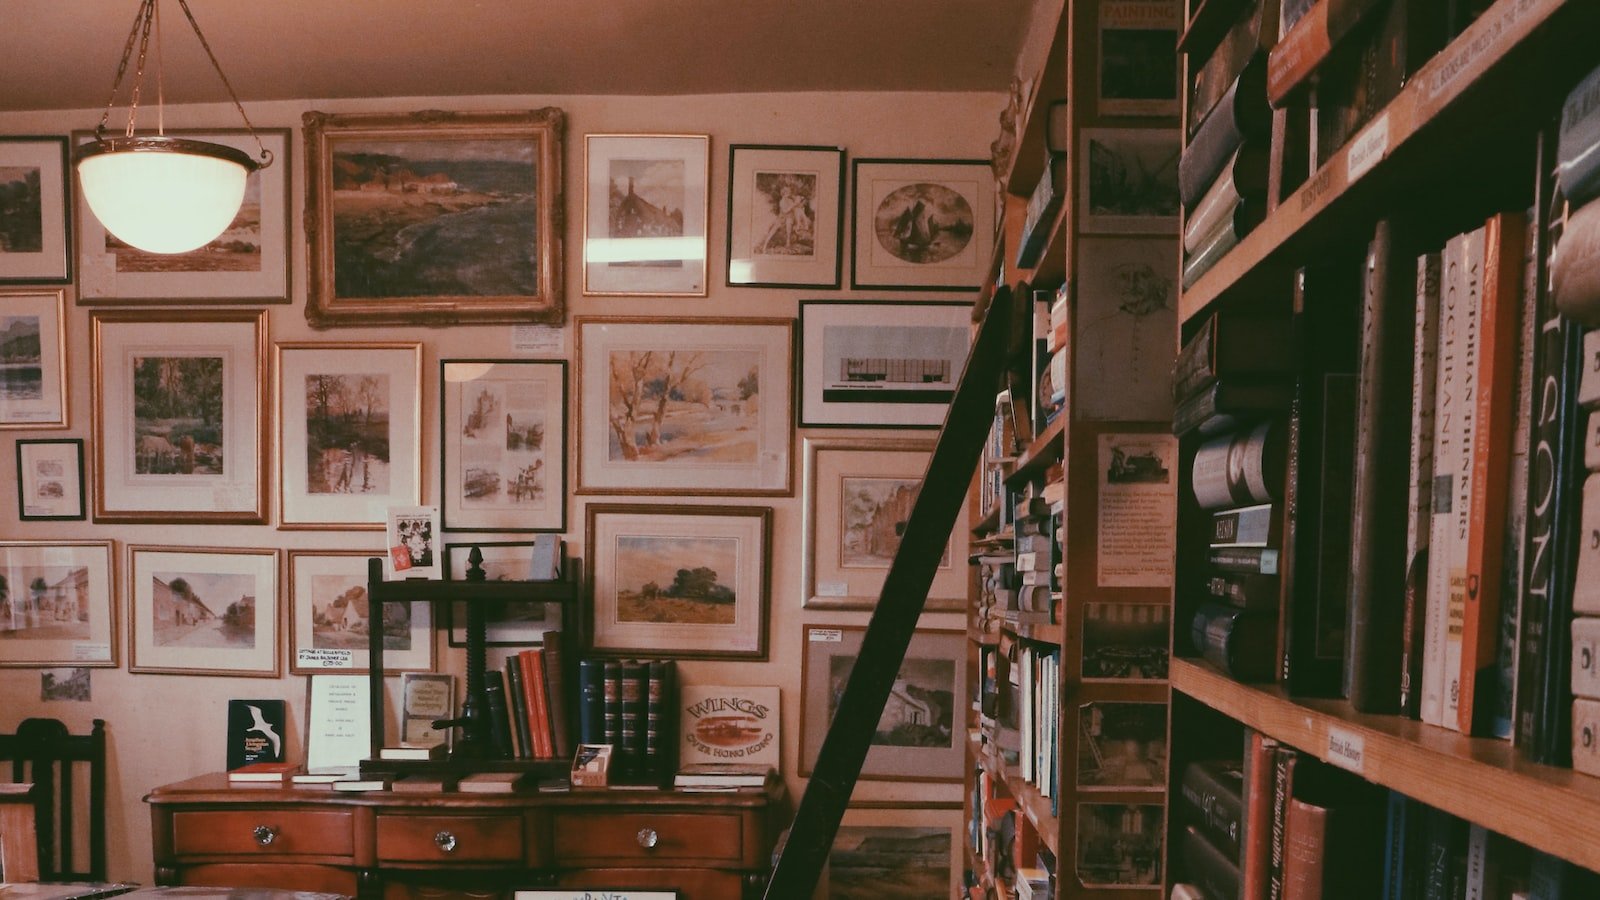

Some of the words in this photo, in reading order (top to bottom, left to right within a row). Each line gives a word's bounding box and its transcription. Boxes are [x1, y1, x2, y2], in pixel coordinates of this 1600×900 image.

[1103, 6, 1176, 19] PAINTING
[1466, 262, 1478, 402] VICTORIAN
[1441, 261, 1457, 457] COCHRANE
[1460, 410, 1472, 541] THINKERS
[687, 697, 769, 719] WINGS
[687, 732, 711, 756] OVER
[713, 747, 745, 758] HONG
[746, 732, 774, 756] KONG
[1275, 762, 1286, 787] The
[1272, 788, 1285, 827] Royal
